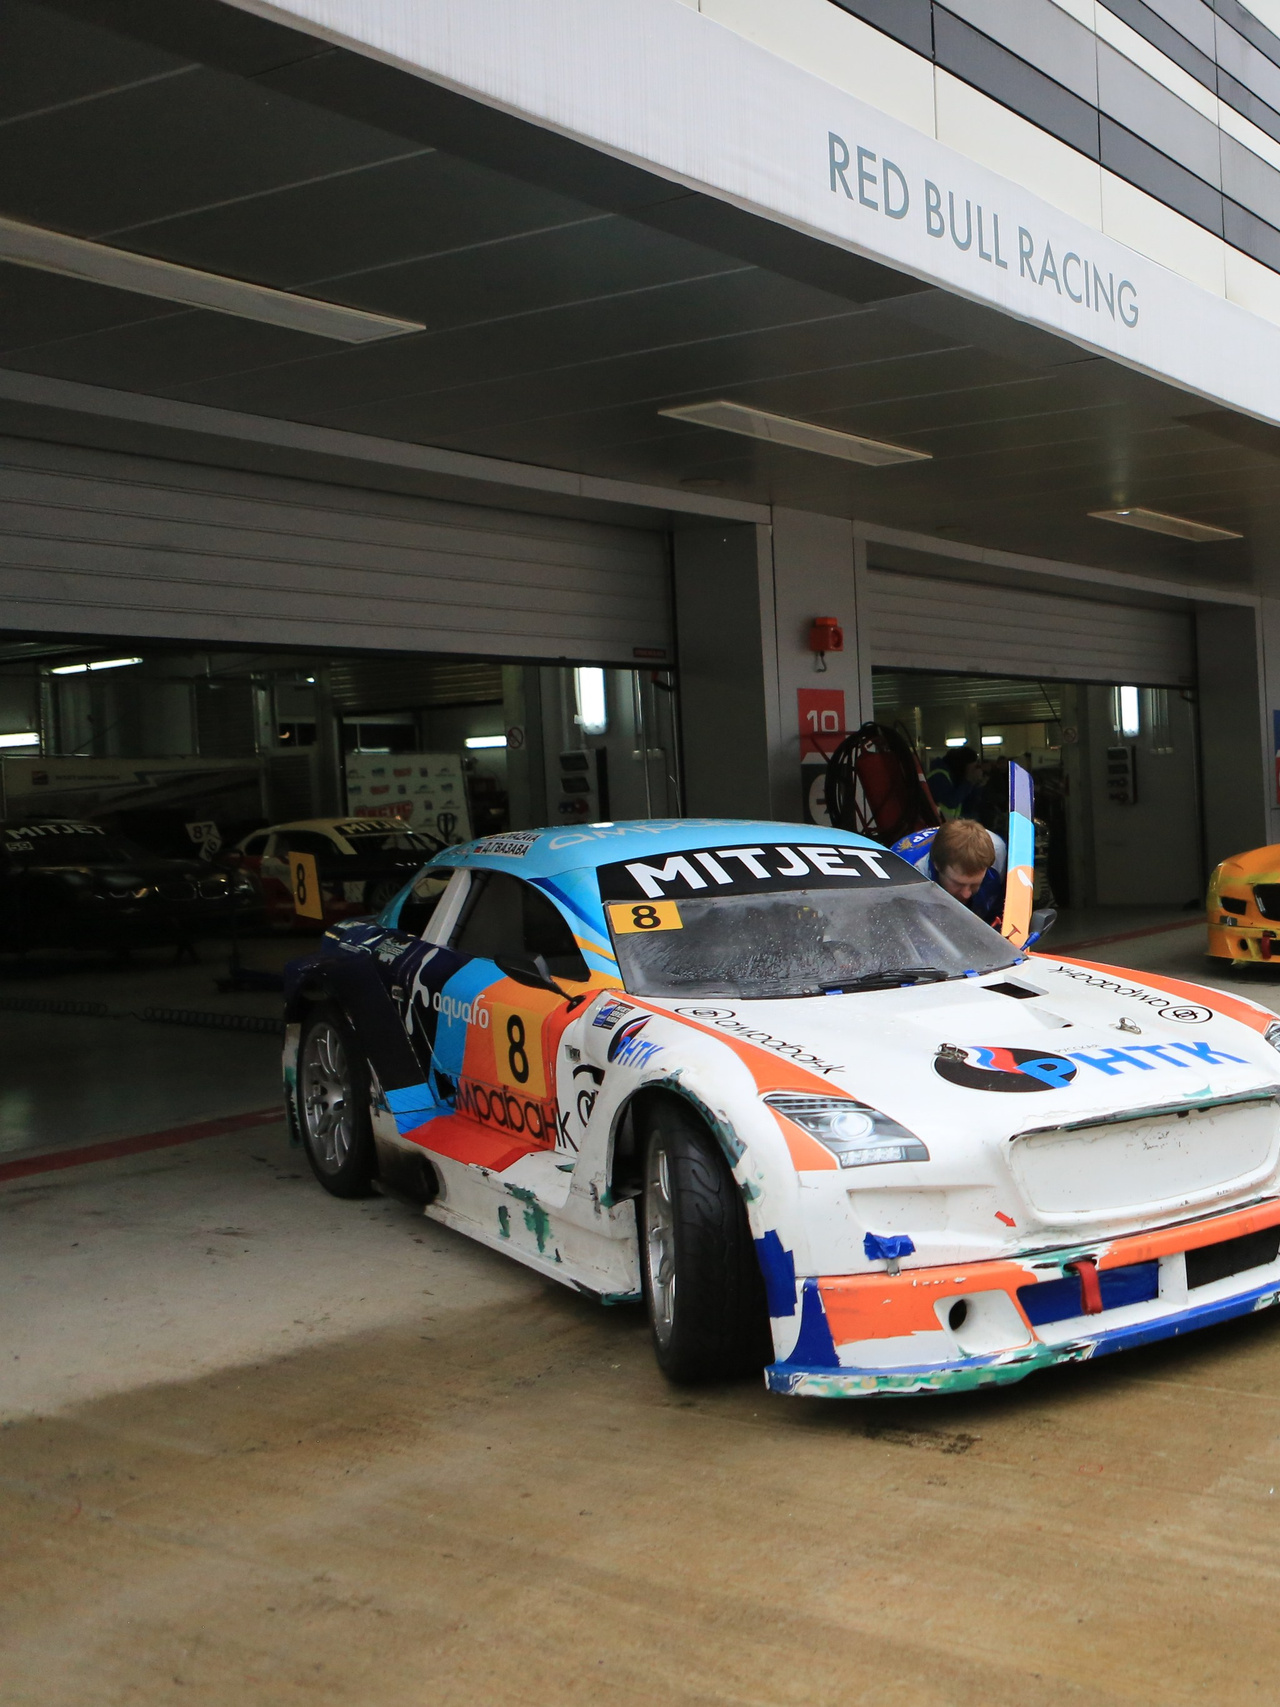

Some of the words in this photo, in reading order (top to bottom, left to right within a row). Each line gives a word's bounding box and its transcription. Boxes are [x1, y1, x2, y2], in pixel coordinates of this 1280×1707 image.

[827, 130, 910, 221] RED
[924, 178, 1008, 270] BULL
[1018, 225, 1139, 329] RACING
[806, 709, 839, 733] 10
[5, 824, 106, 840] MITJET
[480, 841, 530, 856] Д.ГВАЗАВА
[296, 862, 308, 905] 8
[624, 846, 890, 899] MITJET
[631, 904, 662, 930] 8
[432, 991, 490, 1029] aquafo
[506, 1013, 530, 1084] 8
[1013, 1041, 1253, 1089] РНТК
